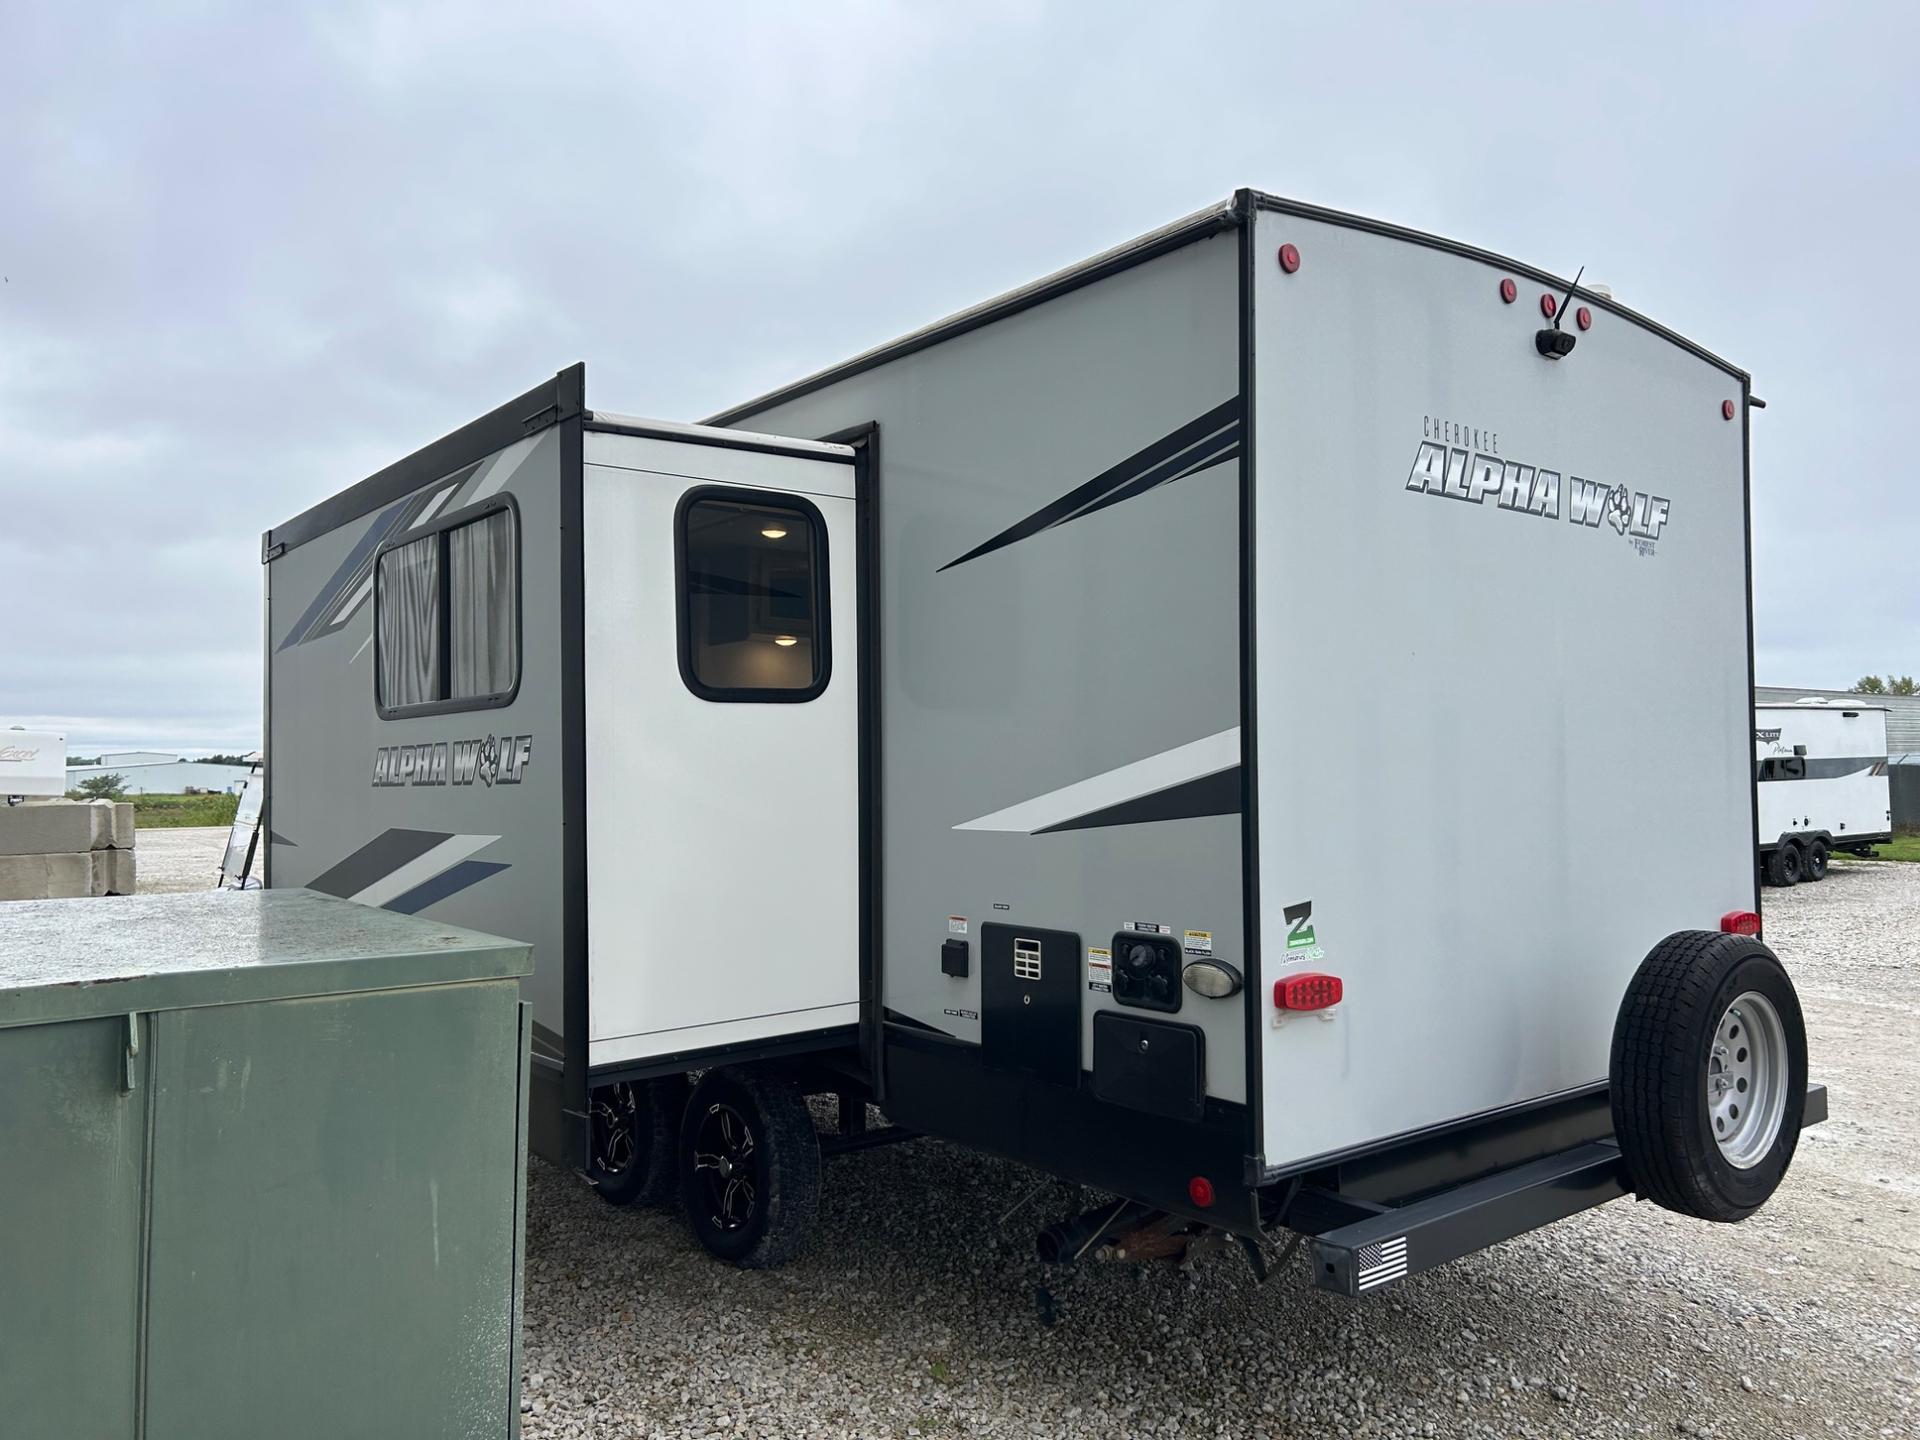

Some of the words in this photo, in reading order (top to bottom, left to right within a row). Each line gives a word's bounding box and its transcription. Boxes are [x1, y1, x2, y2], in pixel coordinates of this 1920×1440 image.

[1424, 415, 1499, 454] CHEROKEE
[1405, 440, 1562, 520] ALPHA
[372, 742, 448, 787] ALPHA
